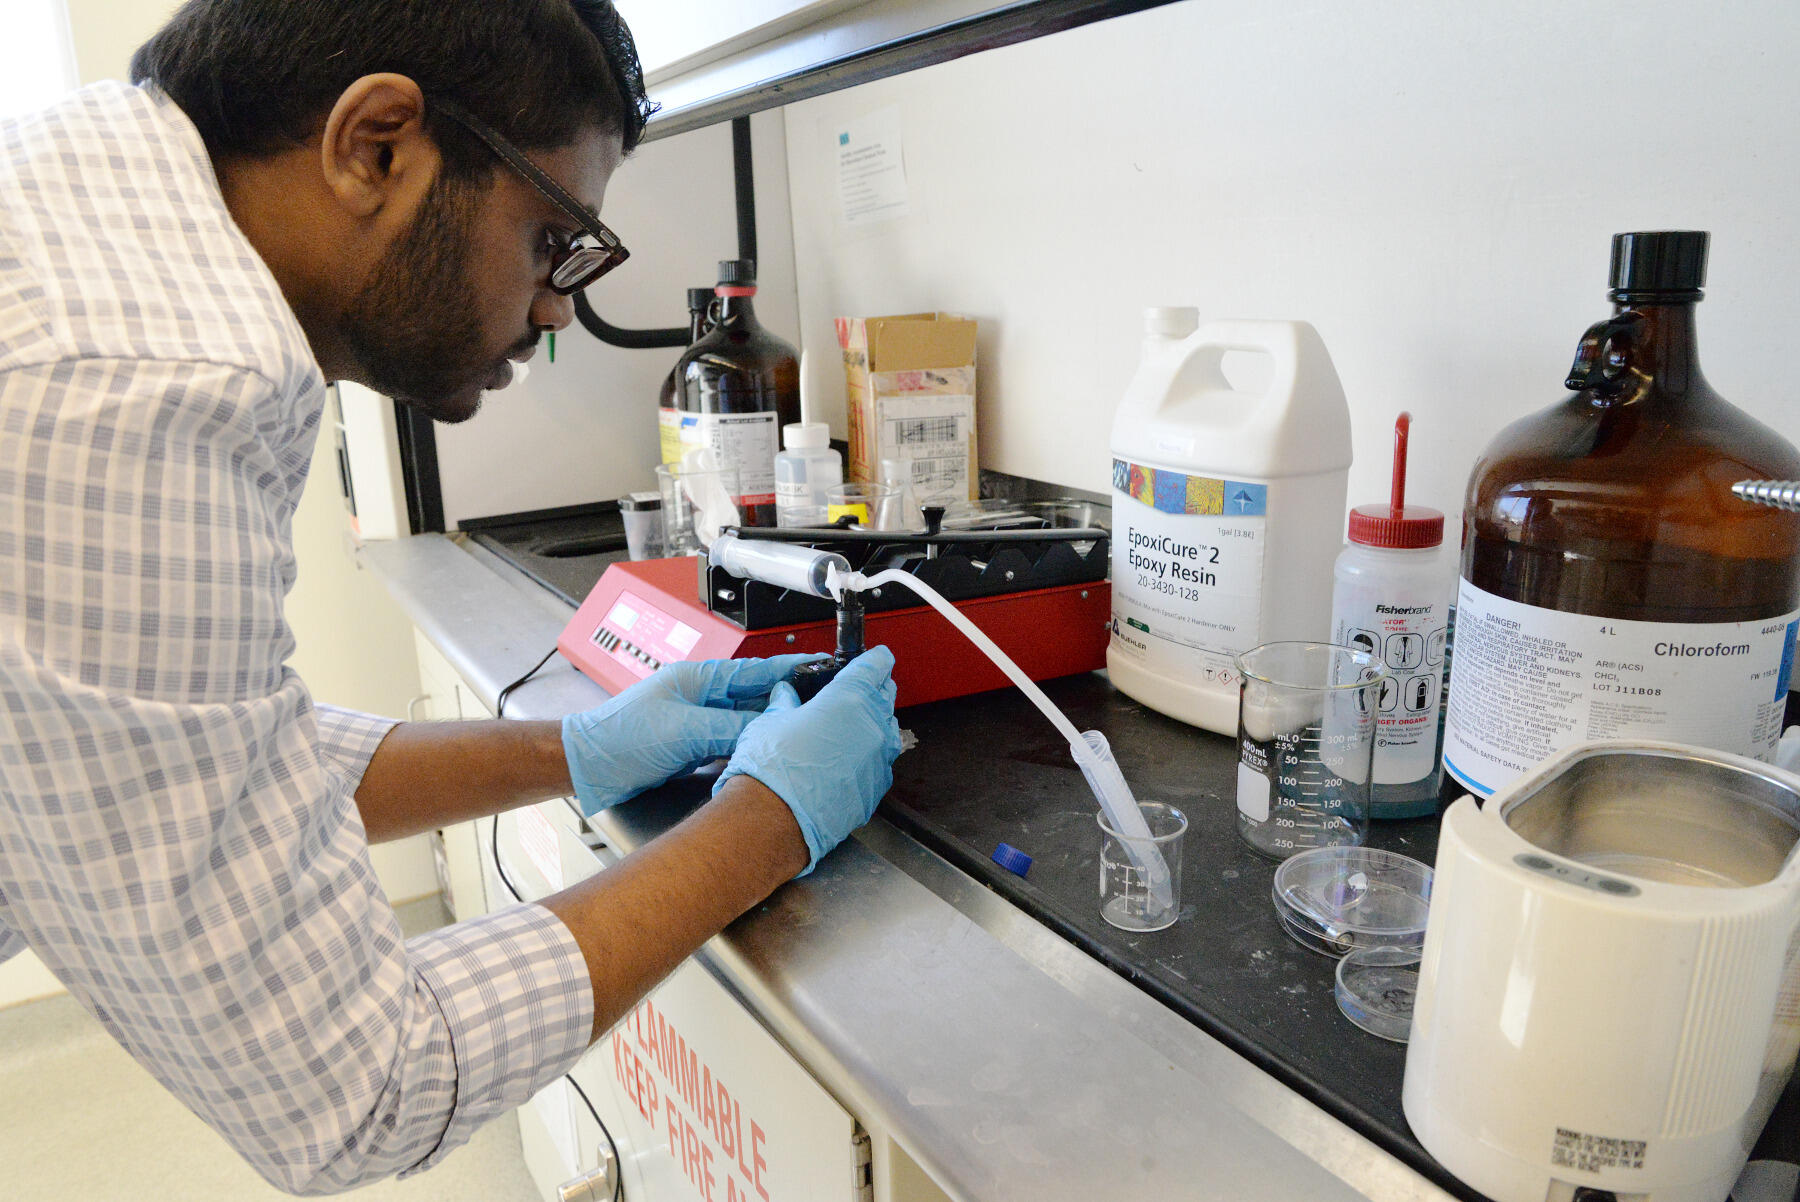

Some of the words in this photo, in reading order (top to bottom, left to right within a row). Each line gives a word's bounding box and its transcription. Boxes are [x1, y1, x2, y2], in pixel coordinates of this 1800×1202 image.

[1209, 546, 1220, 564] 2
[1128, 548, 1166, 579] Epoxy
[1171, 561, 1216, 587] Resin
[1137, 574, 1199, 602] 20-3430-128
[1376, 604, 1432, 615] Fisherbrand
[1486, 612, 1521, 631] DANGER!
[1219, 624, 1236, 632] ONLY
[1600, 626, 1606, 634] 4
[1610, 627, 1616, 635] L
[1120, 633, 1147, 651] BUEHLER
[1522, 634, 1553, 647] INHALED
[1554, 641, 1567, 649] OR
[1483, 641, 1509, 657] NERVOUS
[1487, 633, 1528, 654] RESPIRATORY
[1558, 655, 1576, 664] MAY
[1510, 638, 1537, 650] CAUSES
[1540, 645, 1583, 659] IRRITATION
[1654, 642, 1750, 657] Chloroform
[1509, 657, 1528, 667] LIVER
[1529, 662, 1545, 671] AND
[1618, 663, 1644, 672] (ACS)
[1507, 662, 1522, 672] MAY
[1523, 666, 1548, 679] CAUSE
[1493, 665, 1518, 678] depends
[1529, 675, 1546, 685] level
[1547, 680, 1561, 688] and
[1503, 681, 1518, 691] Keep
[1519, 687, 1549, 699] container
[1547, 686, 1557, 694] Do
[1571, 691, 1583, 699] get
[1593, 683, 1610, 692] LOT
[1498, 692, 1511, 701] case
[1399, 717, 1428, 725] ORGANS
[1538, 711, 1557, 720] water
[1545, 718, 1573, 731] clothing
[1277, 733, 1291, 742] mL
[1327, 735, 1345, 745] 300
[1274, 742, 1295, 752] ±5%
[1520, 744, 1529, 753] by
[1530, 747, 1551, 757] mouth
[1532, 742, 1548, 751] Give
[1511, 747, 1535, 760] medical
[1285, 756, 1298, 765] 50
[1327, 757, 1344, 766] 250
[1480, 749, 1501, 764] SAFETY
[1502, 760, 1521, 772] DATA
[1278, 776, 1297, 786] 100
[1325, 778, 1342, 787] 200
[1278, 797, 1296, 807] 150
[1324, 800, 1341, 809] 150
[1276, 818, 1295, 828] 200
[1322, 821, 1340, 829] 100
[1275, 838, 1293, 849] 250
[1327, 840, 1338, 848] 50
[612, 1027, 659, 1130] KEEP
[665, 1095, 716, 1202] FIRE
